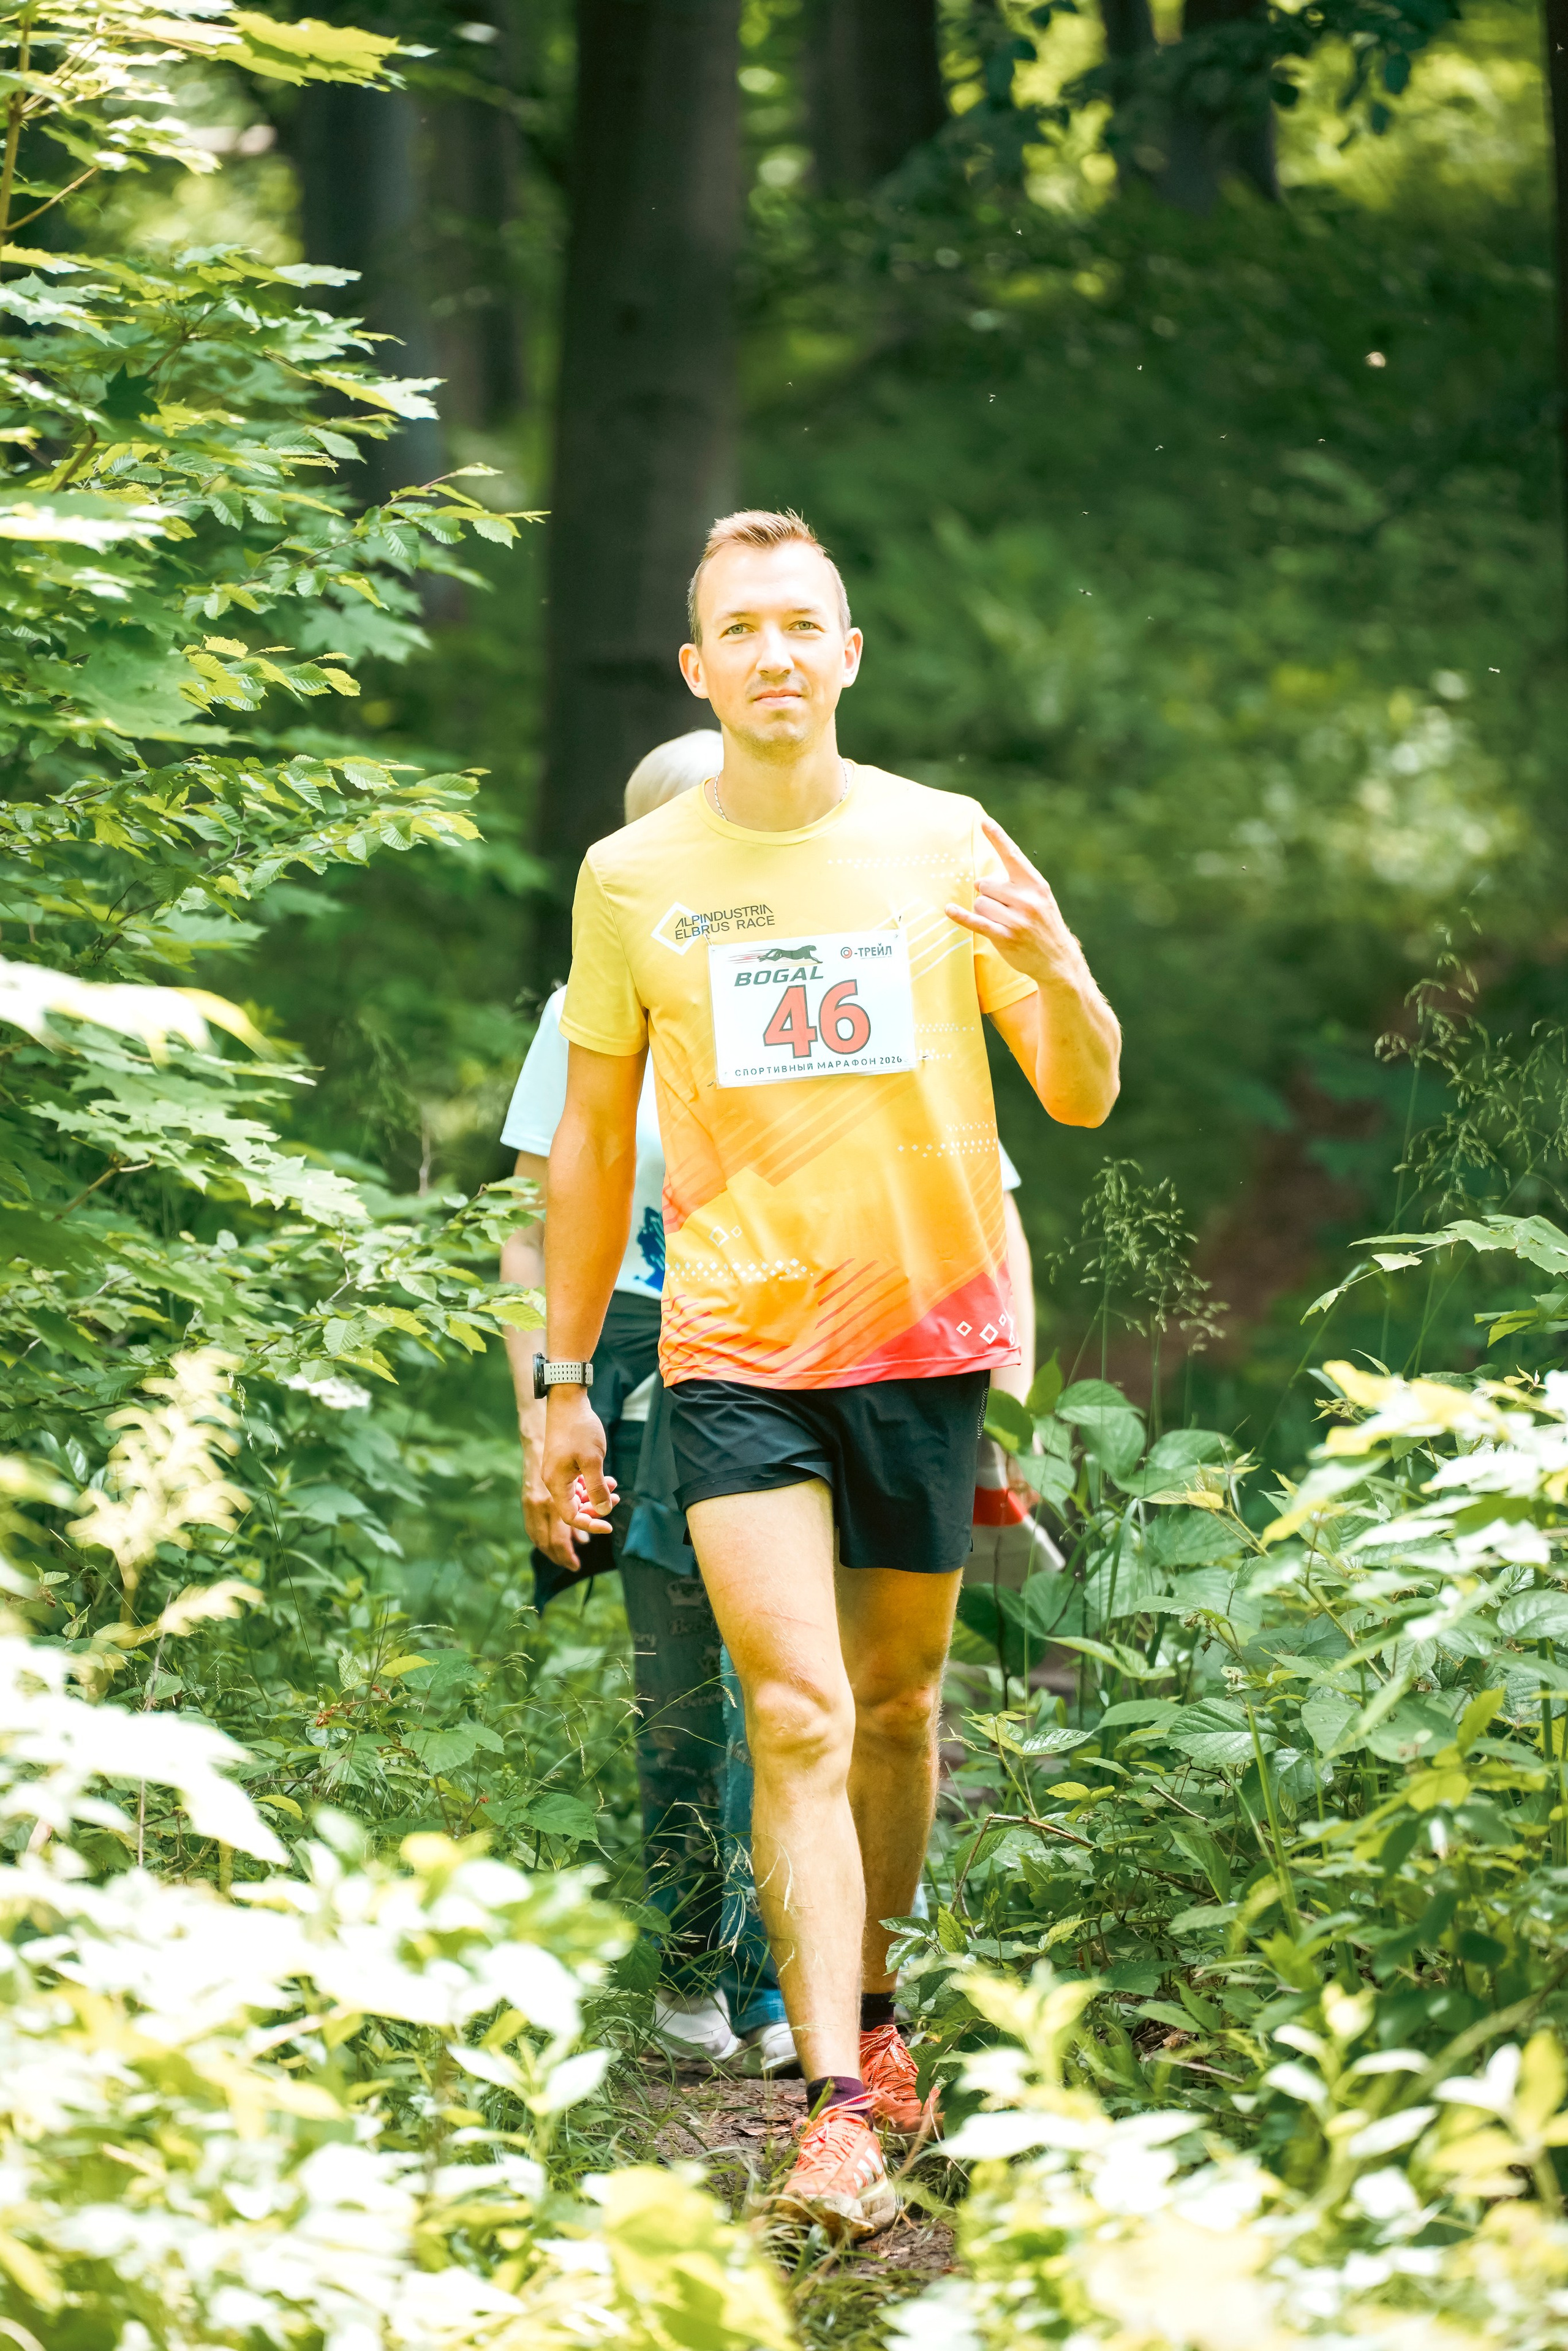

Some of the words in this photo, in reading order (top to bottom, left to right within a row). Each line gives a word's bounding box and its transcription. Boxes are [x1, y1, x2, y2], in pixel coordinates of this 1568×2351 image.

[675, 904, 773, 929] ALPINDUSTRIA
[675, 921, 730, 940] ELBRUS
[737, 915, 775, 930] RACE
[734, 966, 824, 987] BOGAL
[763, 979, 871, 1059] 46
[735, 1063, 813, 1077] СПОРТИВНЫЙ
[817, 1058, 876, 1070] МАРАФОН
[880, 1056, 902, 1065] 2026
